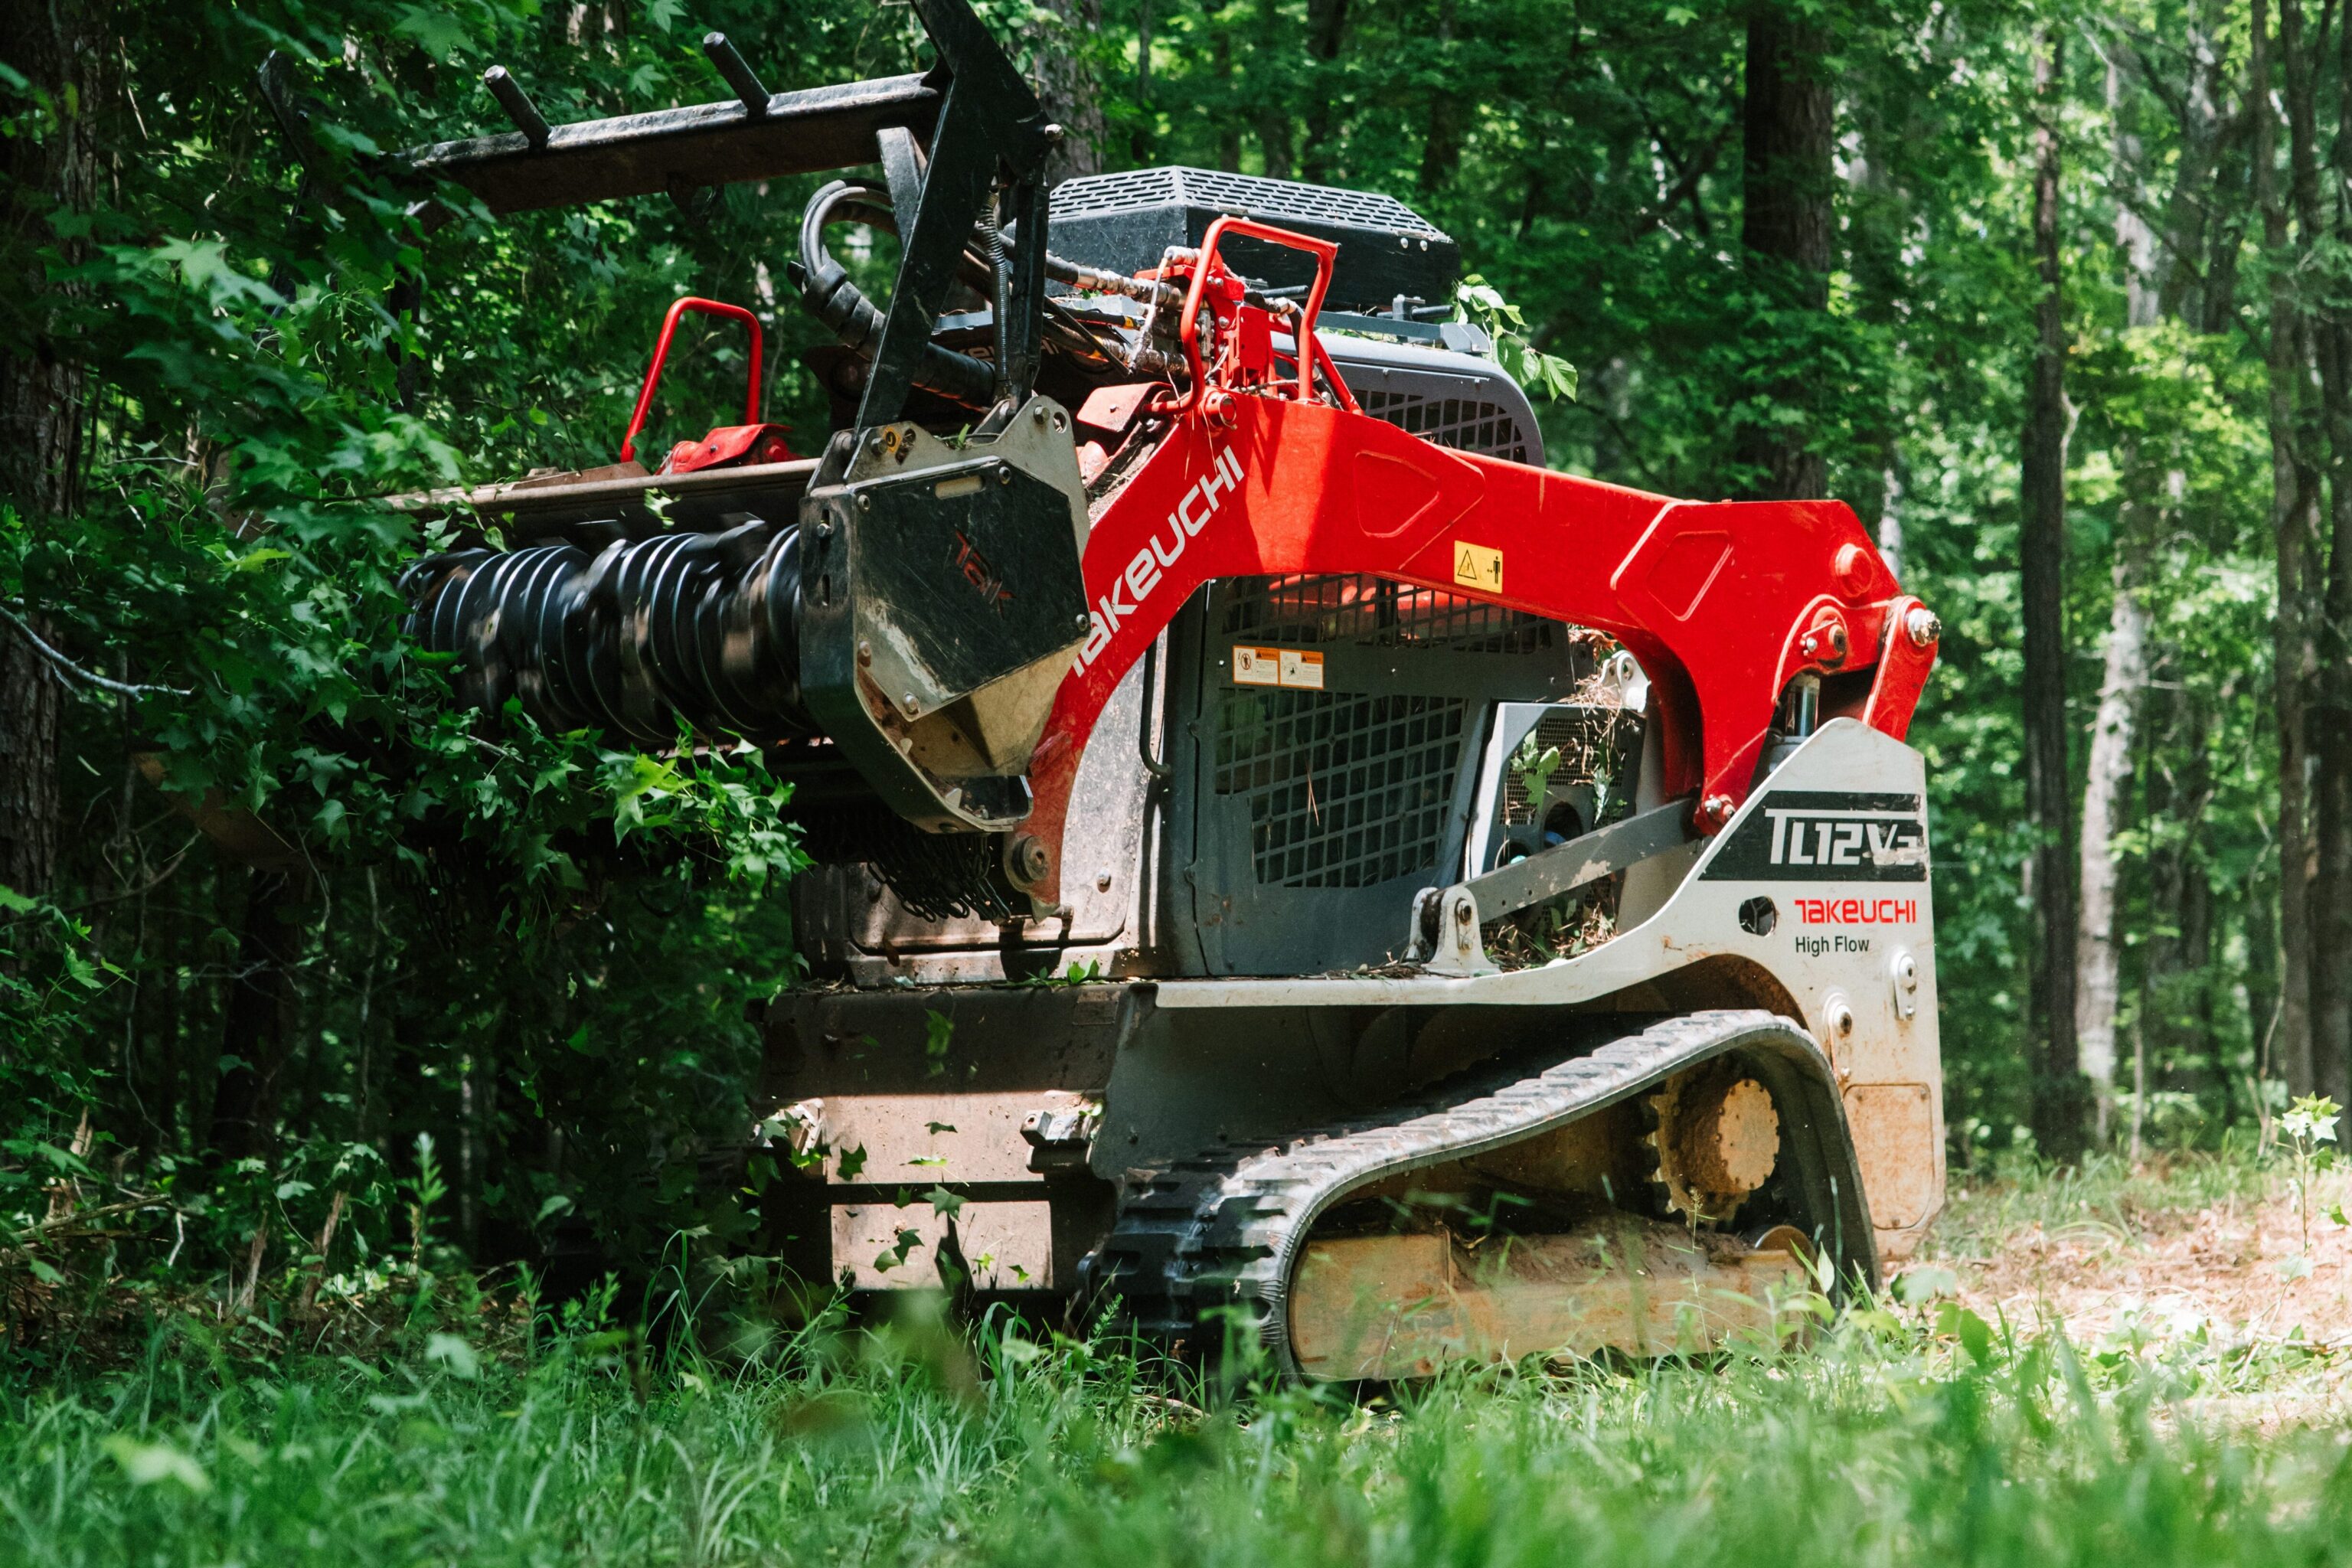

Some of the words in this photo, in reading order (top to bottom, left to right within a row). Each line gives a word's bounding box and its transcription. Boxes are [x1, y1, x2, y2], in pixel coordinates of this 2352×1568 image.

[1795, 900, 1917, 924] TAKEUCHI
[1795, 936, 1830, 957] High
[1834, 936, 1870, 952] Flow
